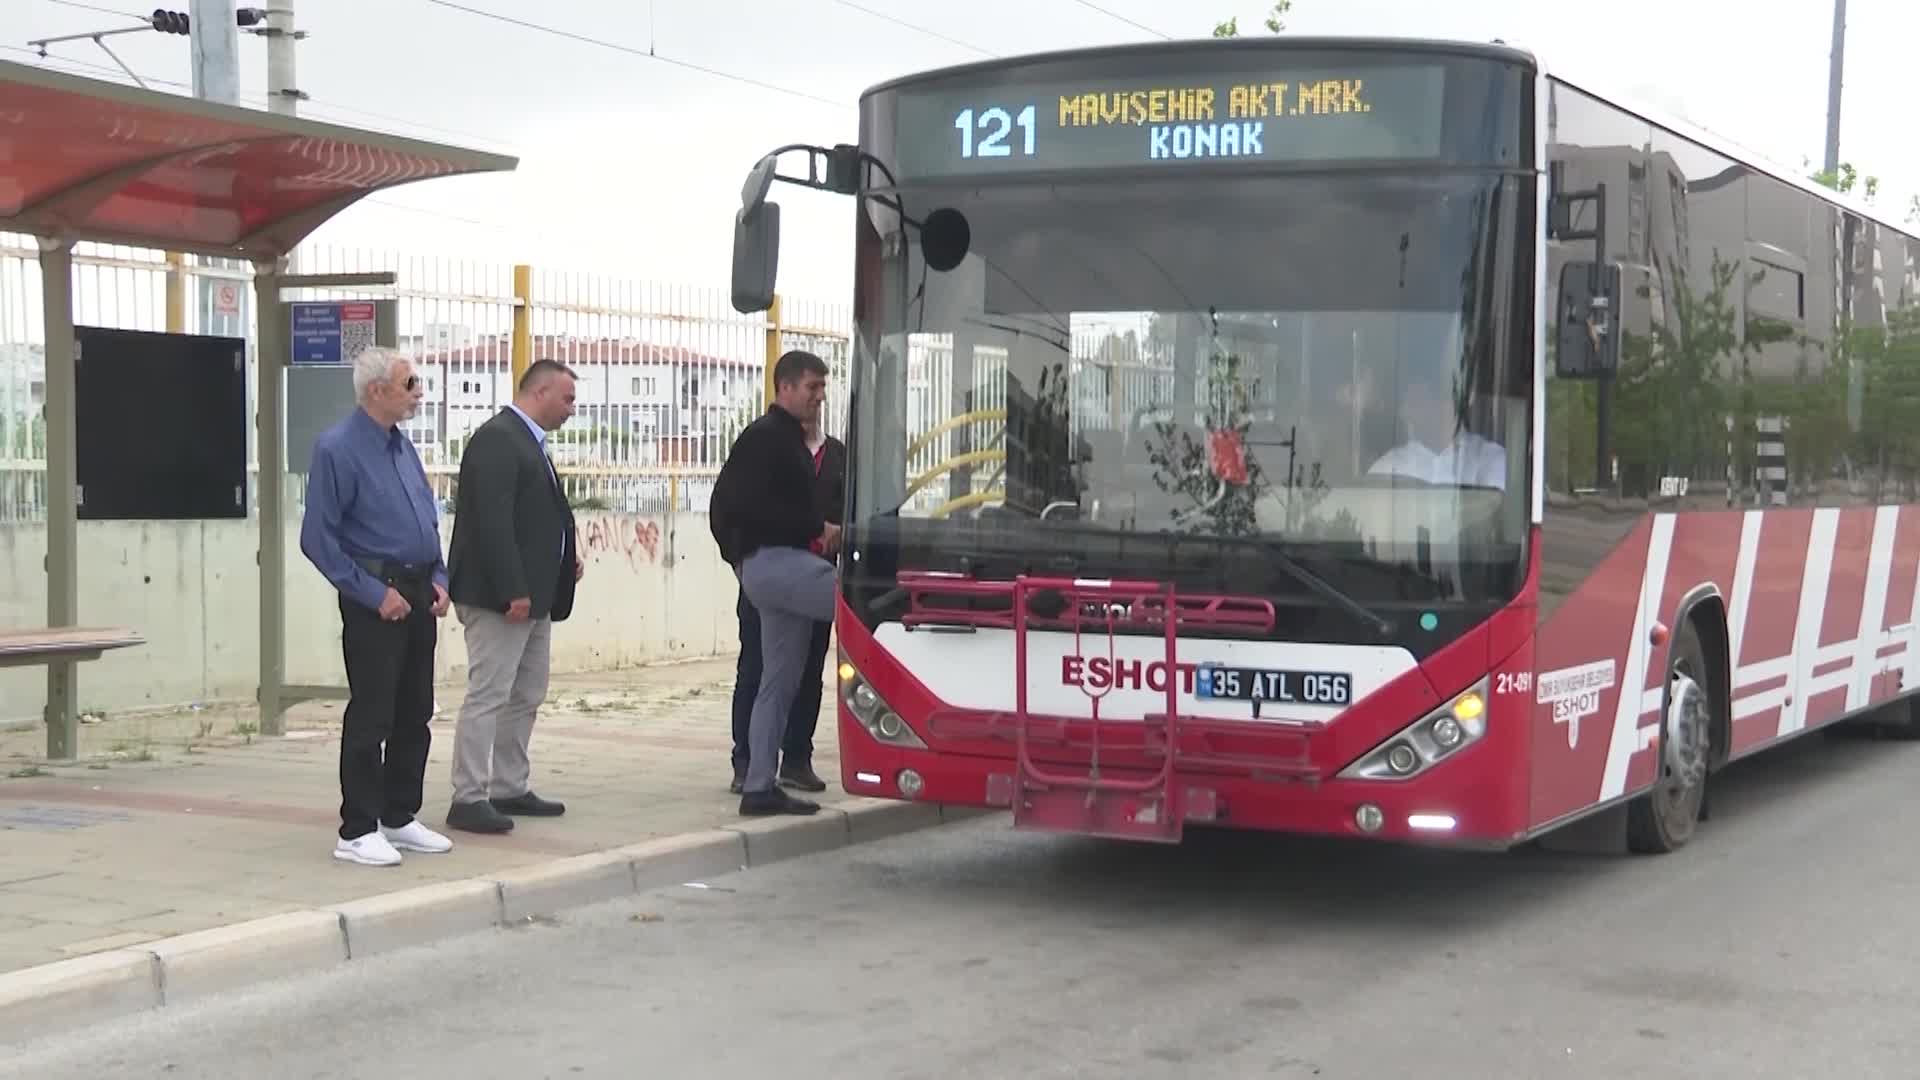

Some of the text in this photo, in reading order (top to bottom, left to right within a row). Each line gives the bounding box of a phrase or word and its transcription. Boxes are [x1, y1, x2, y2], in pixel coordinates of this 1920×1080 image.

[1228, 79, 1371, 117] AKT.MRK.
[954, 105, 1036, 158] 121
[1149, 122, 1265, 159] KONAK
[1062, 655, 1197, 694] ESHOT
[1213, 670, 1348, 702] 35 ATL 056
[1555, 692, 1597, 718] ESHOT
